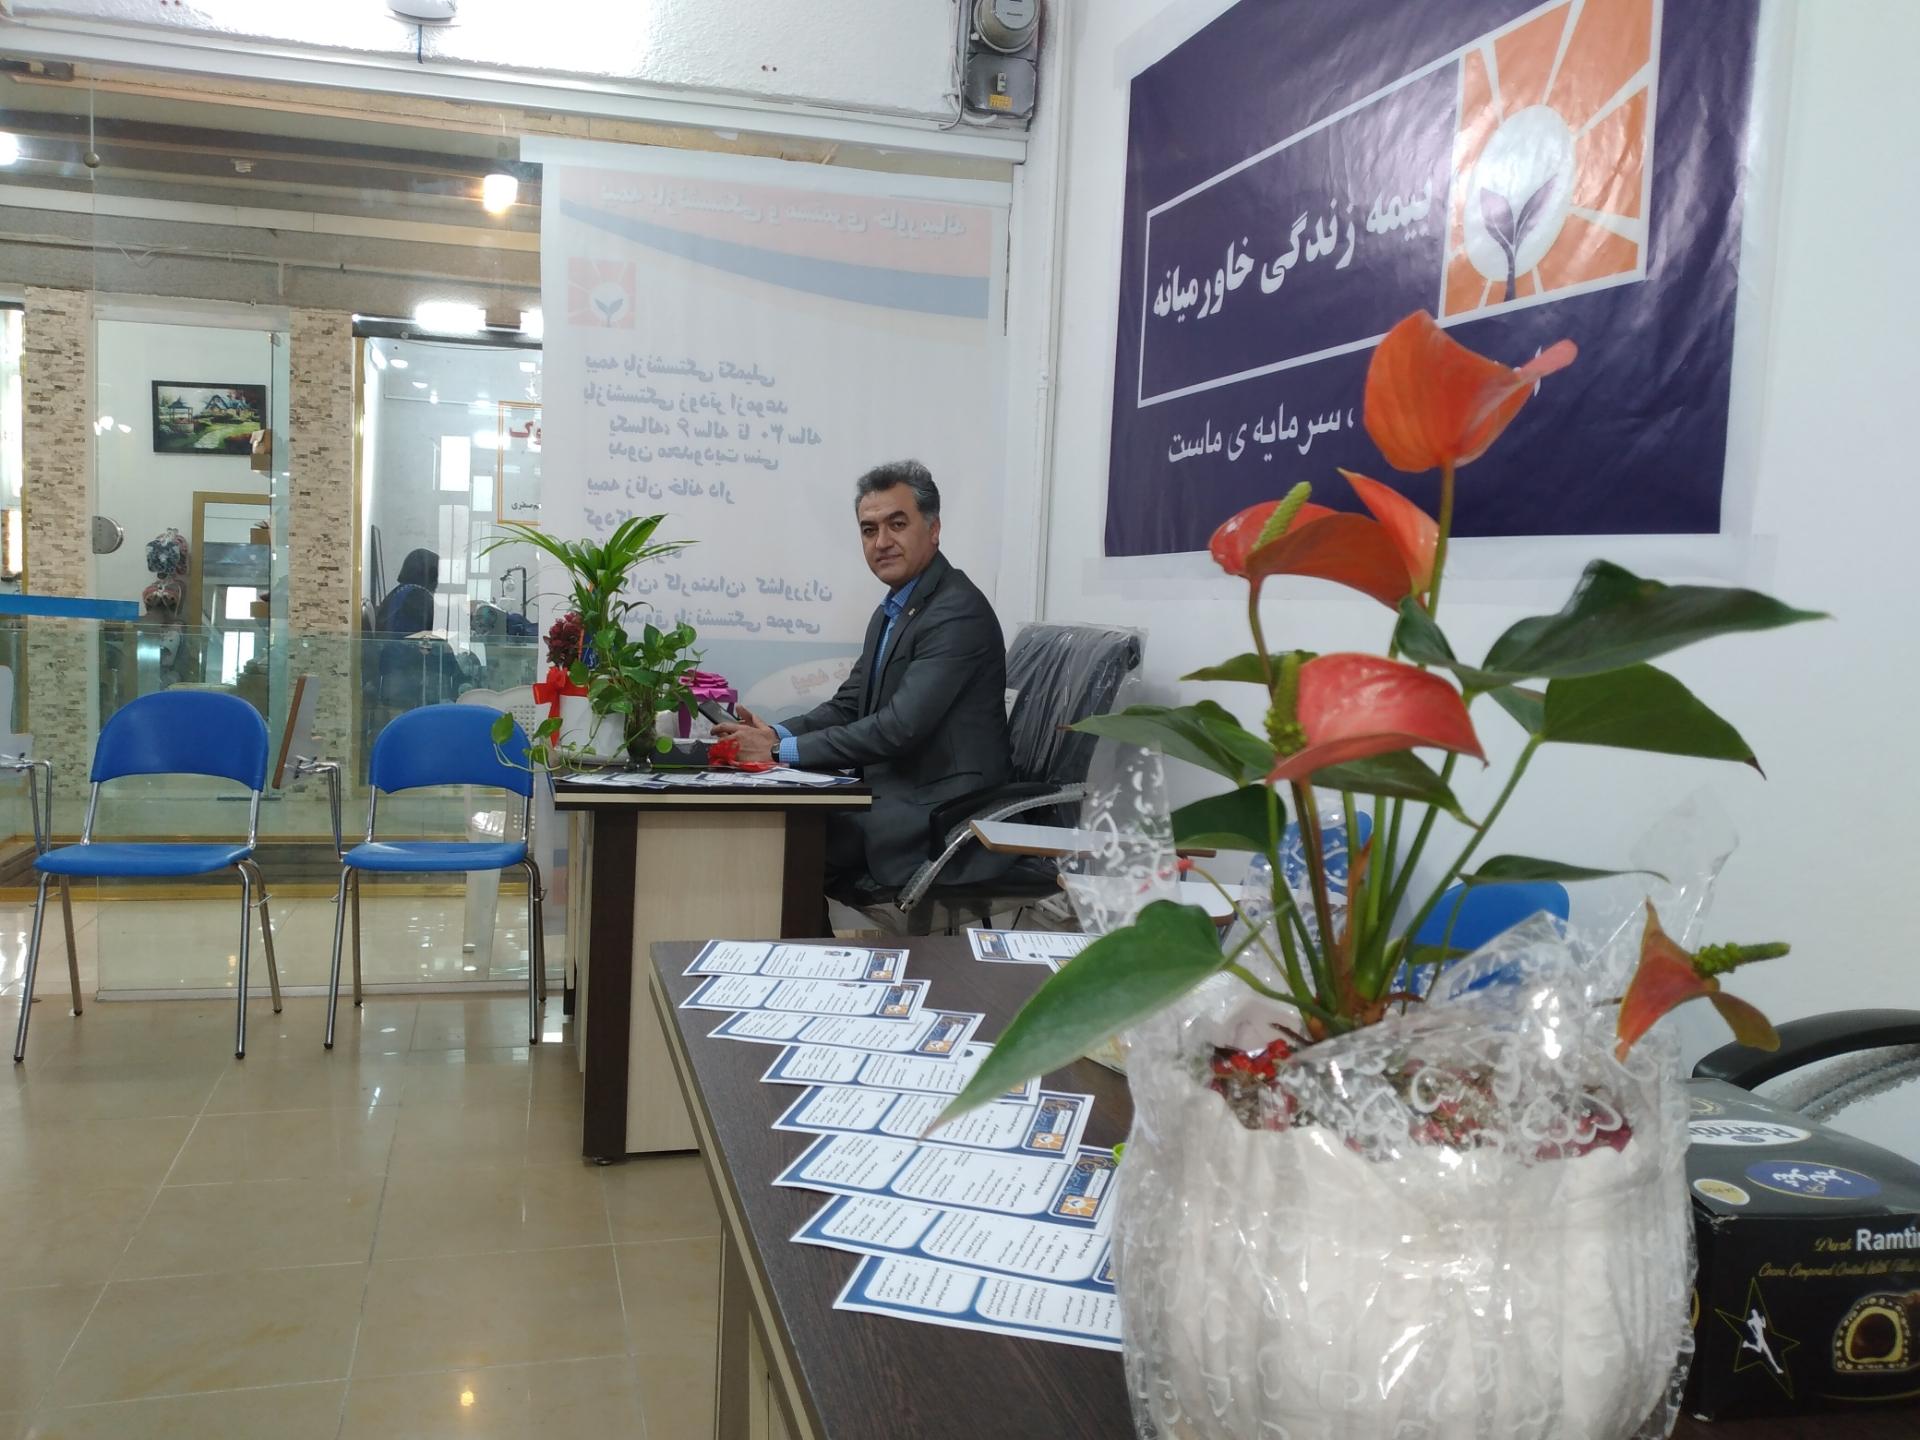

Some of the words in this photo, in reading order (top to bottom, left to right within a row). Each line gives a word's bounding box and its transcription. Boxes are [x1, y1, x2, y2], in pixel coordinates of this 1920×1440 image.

[1365, 180, 1433, 241] بیمه
[1259, 200, 1356, 295] زندگی
[1153, 238, 1254, 323] خاورمیانه
[1166, 417, 1224, 464] ماست
[1252, 402, 1342, 464] سرمایه
